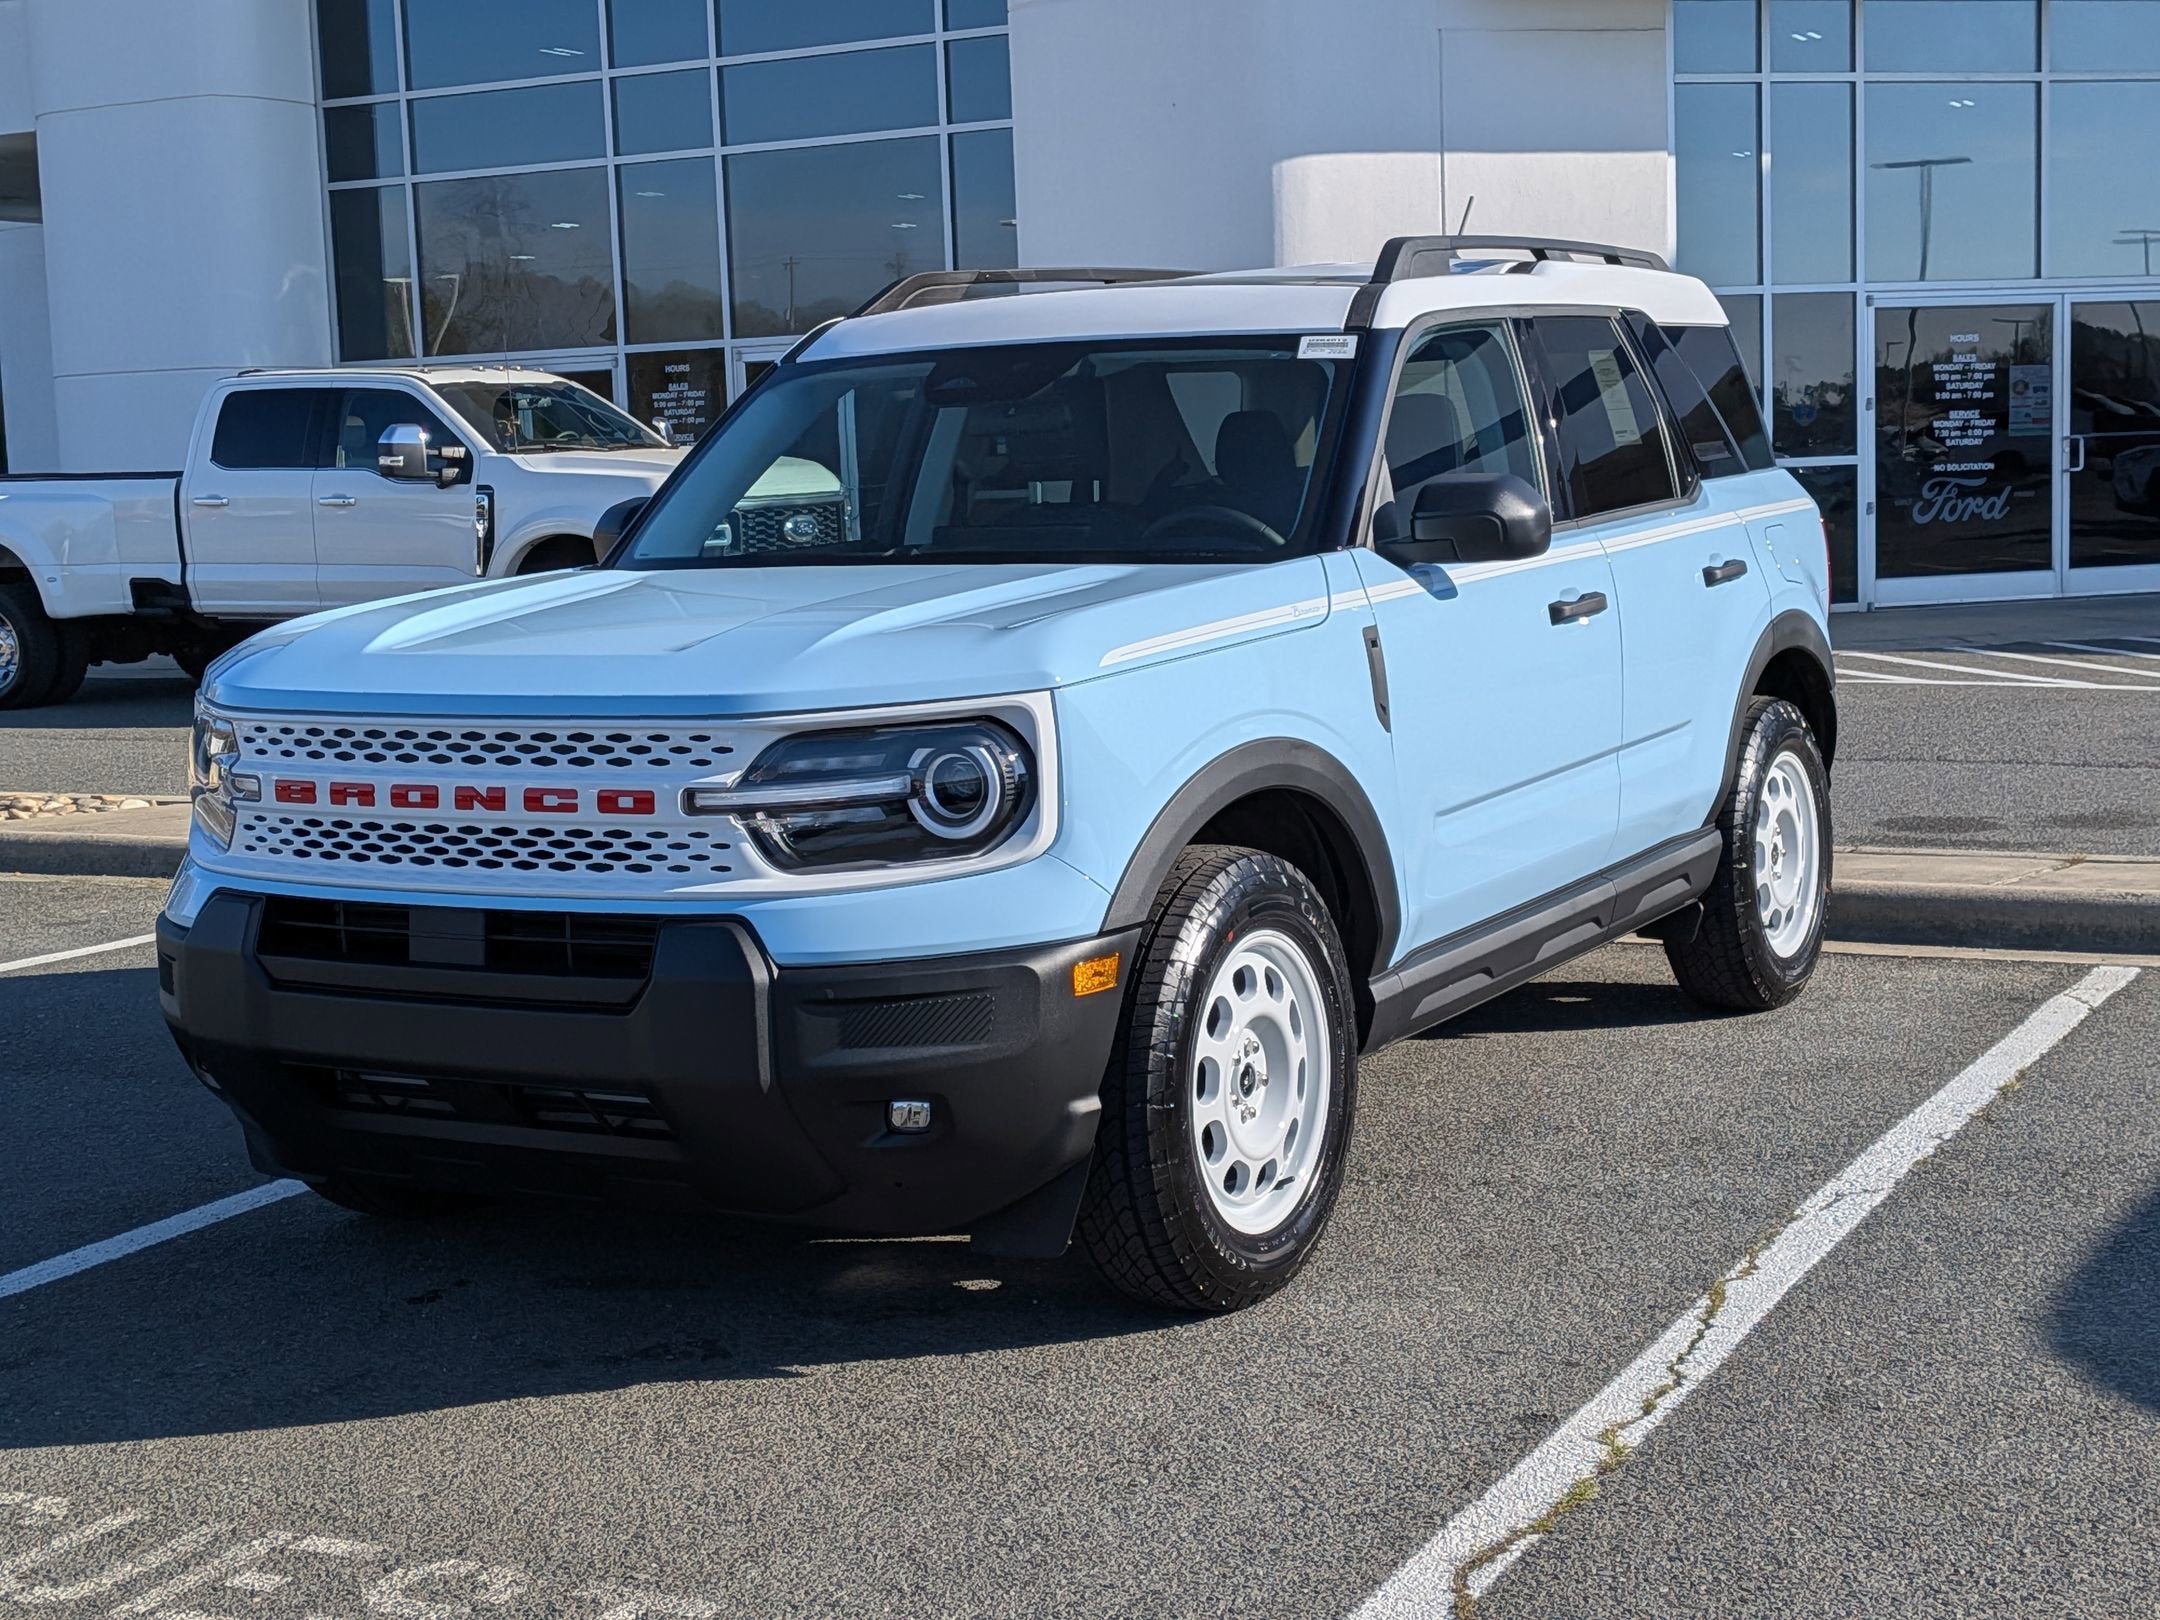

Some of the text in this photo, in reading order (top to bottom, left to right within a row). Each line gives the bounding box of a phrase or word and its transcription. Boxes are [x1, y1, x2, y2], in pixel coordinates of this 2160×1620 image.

[1950, 333, 1980, 343] HOURS
[1952, 354, 1977, 363] SALES
[665, 364, 690, 373] HOURS
[1932, 363, 1963, 371] MONDAY
[1970, 362, 1996, 370] FRIDAY
[668, 383, 688, 391] SALES
[1945, 381, 1984, 390] SATURDAY
[683, 390, 706, 398] FRIDAY
[664, 408, 696, 416] SATURDAY
[1949, 410, 1980, 419] SERVICE
[1932, 420, 1963, 428] MONDAY
[1970, 419, 1996, 427] FRIDAY
[1945, 438, 1984, 446] SATURDAY
[1934, 462, 1995, 472] NO SOLICITATION
[1912, 477, 2013, 524] Ford
[275, 778, 656, 816] BRONCO
